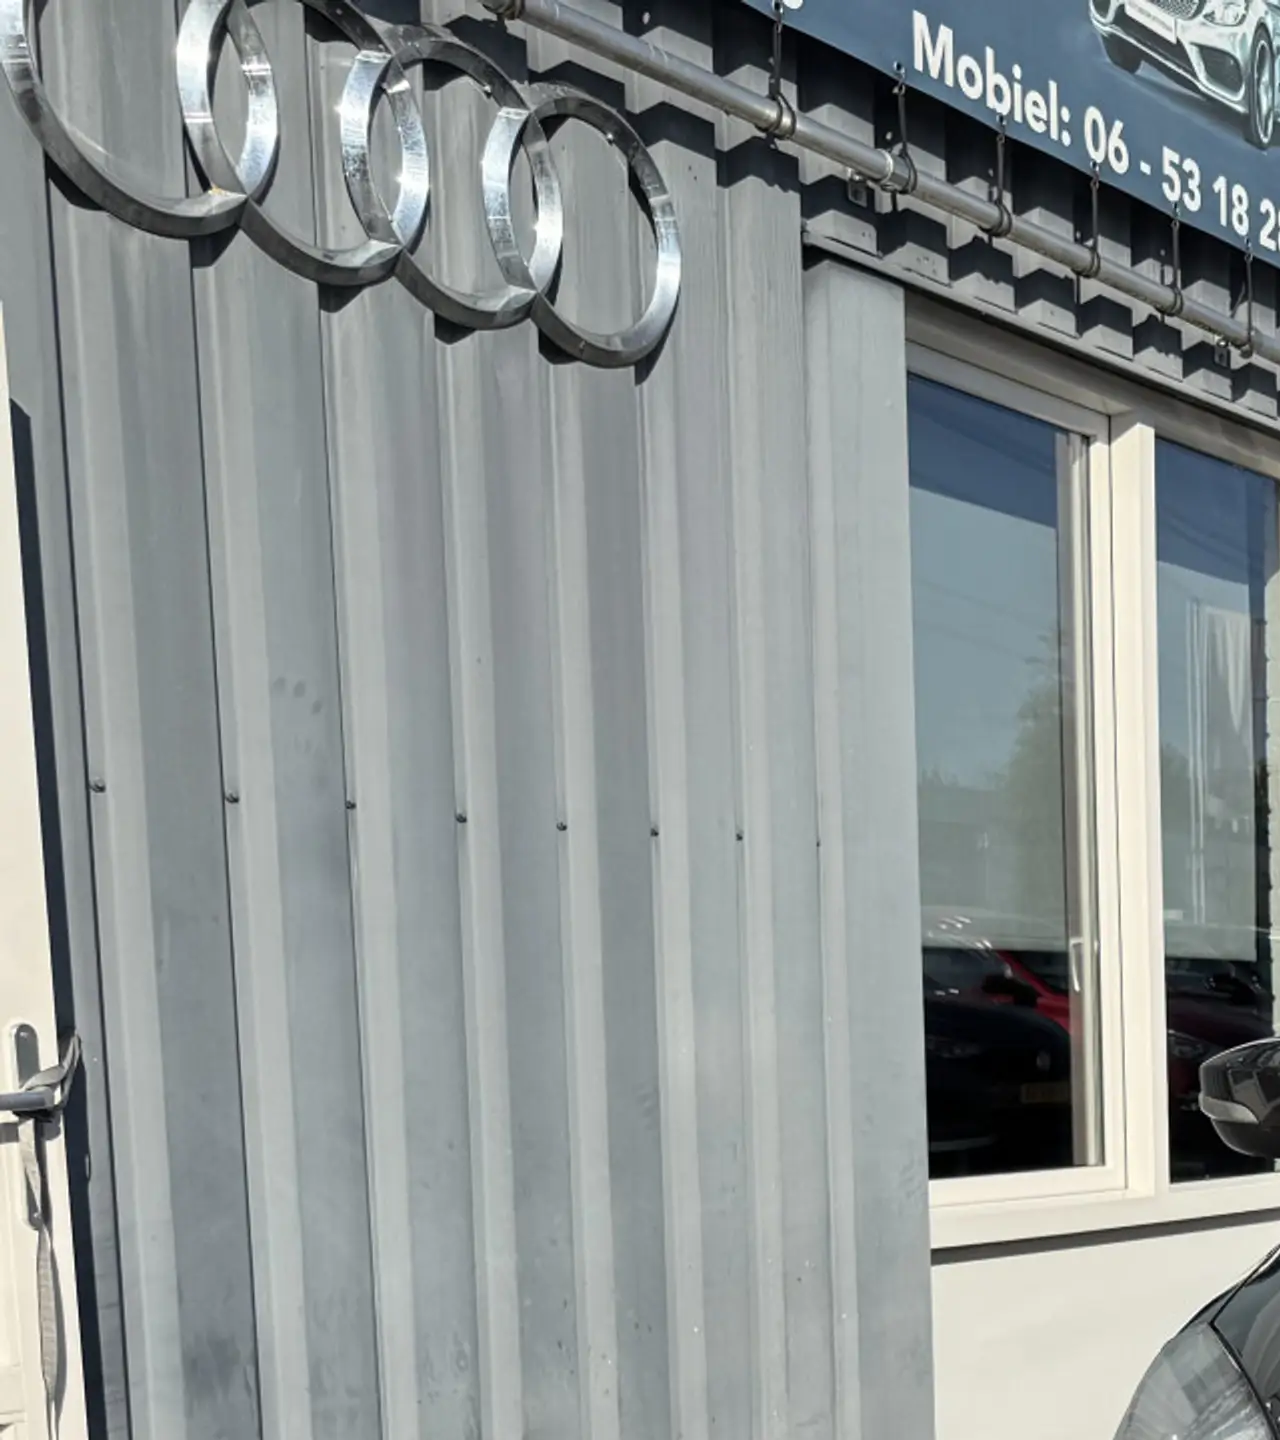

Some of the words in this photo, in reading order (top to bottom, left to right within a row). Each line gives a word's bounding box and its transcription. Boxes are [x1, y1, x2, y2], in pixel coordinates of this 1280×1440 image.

[913, 10, 1072, 147] Mobiel:
[1084, 106, 1130, 175] 06
[1140, 160, 1151, 176] -
[1162, 146, 1201, 213] 53
[1212, 176, 1249, 236] 18
